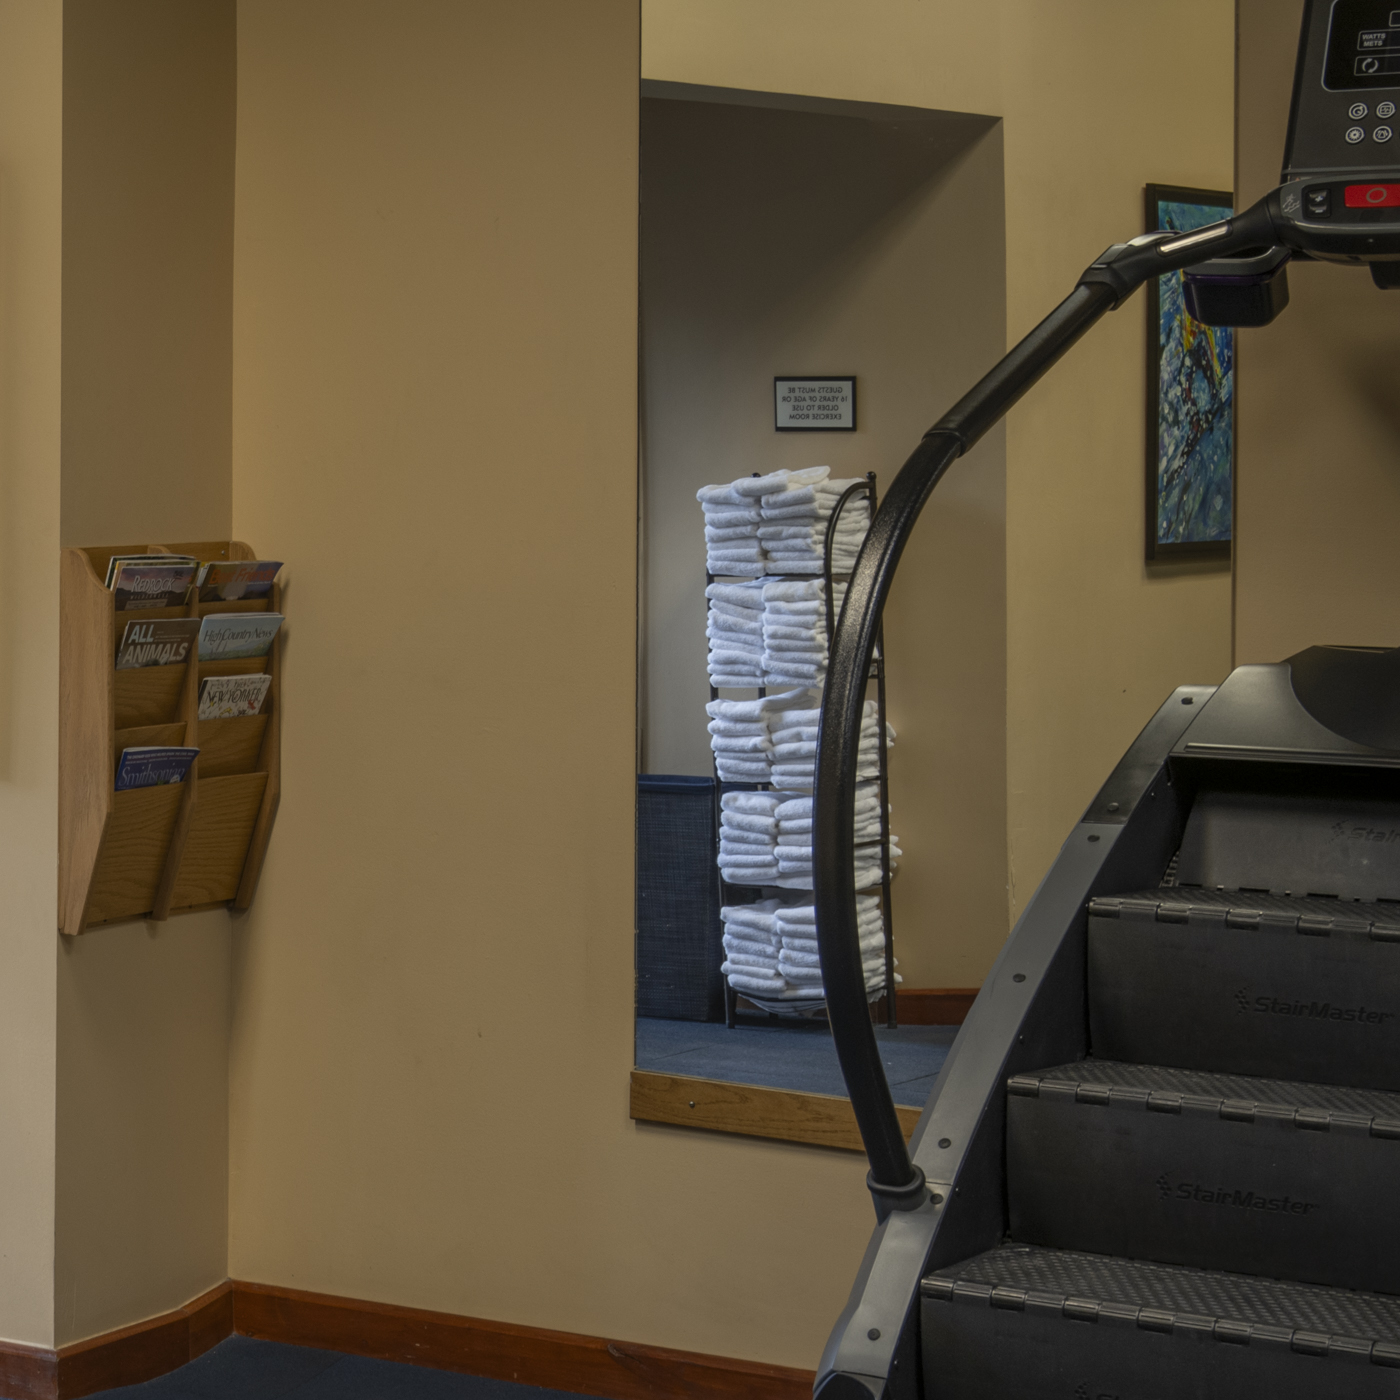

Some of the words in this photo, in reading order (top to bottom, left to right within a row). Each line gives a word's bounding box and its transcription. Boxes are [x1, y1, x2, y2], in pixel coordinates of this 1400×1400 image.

[131, 575, 175, 594] REDROCK
[128, 624, 154, 643] ALL
[203, 628, 221, 645] High
[221, 628, 251, 642] Country
[252, 627, 273, 639] News
[122, 642, 188, 664] ANIMALS
[118, 763, 185, 786] Smithsonian
[1253, 995, 1389, 1025] StairMaster
[1176, 1182, 1316, 1217] StairMaster
